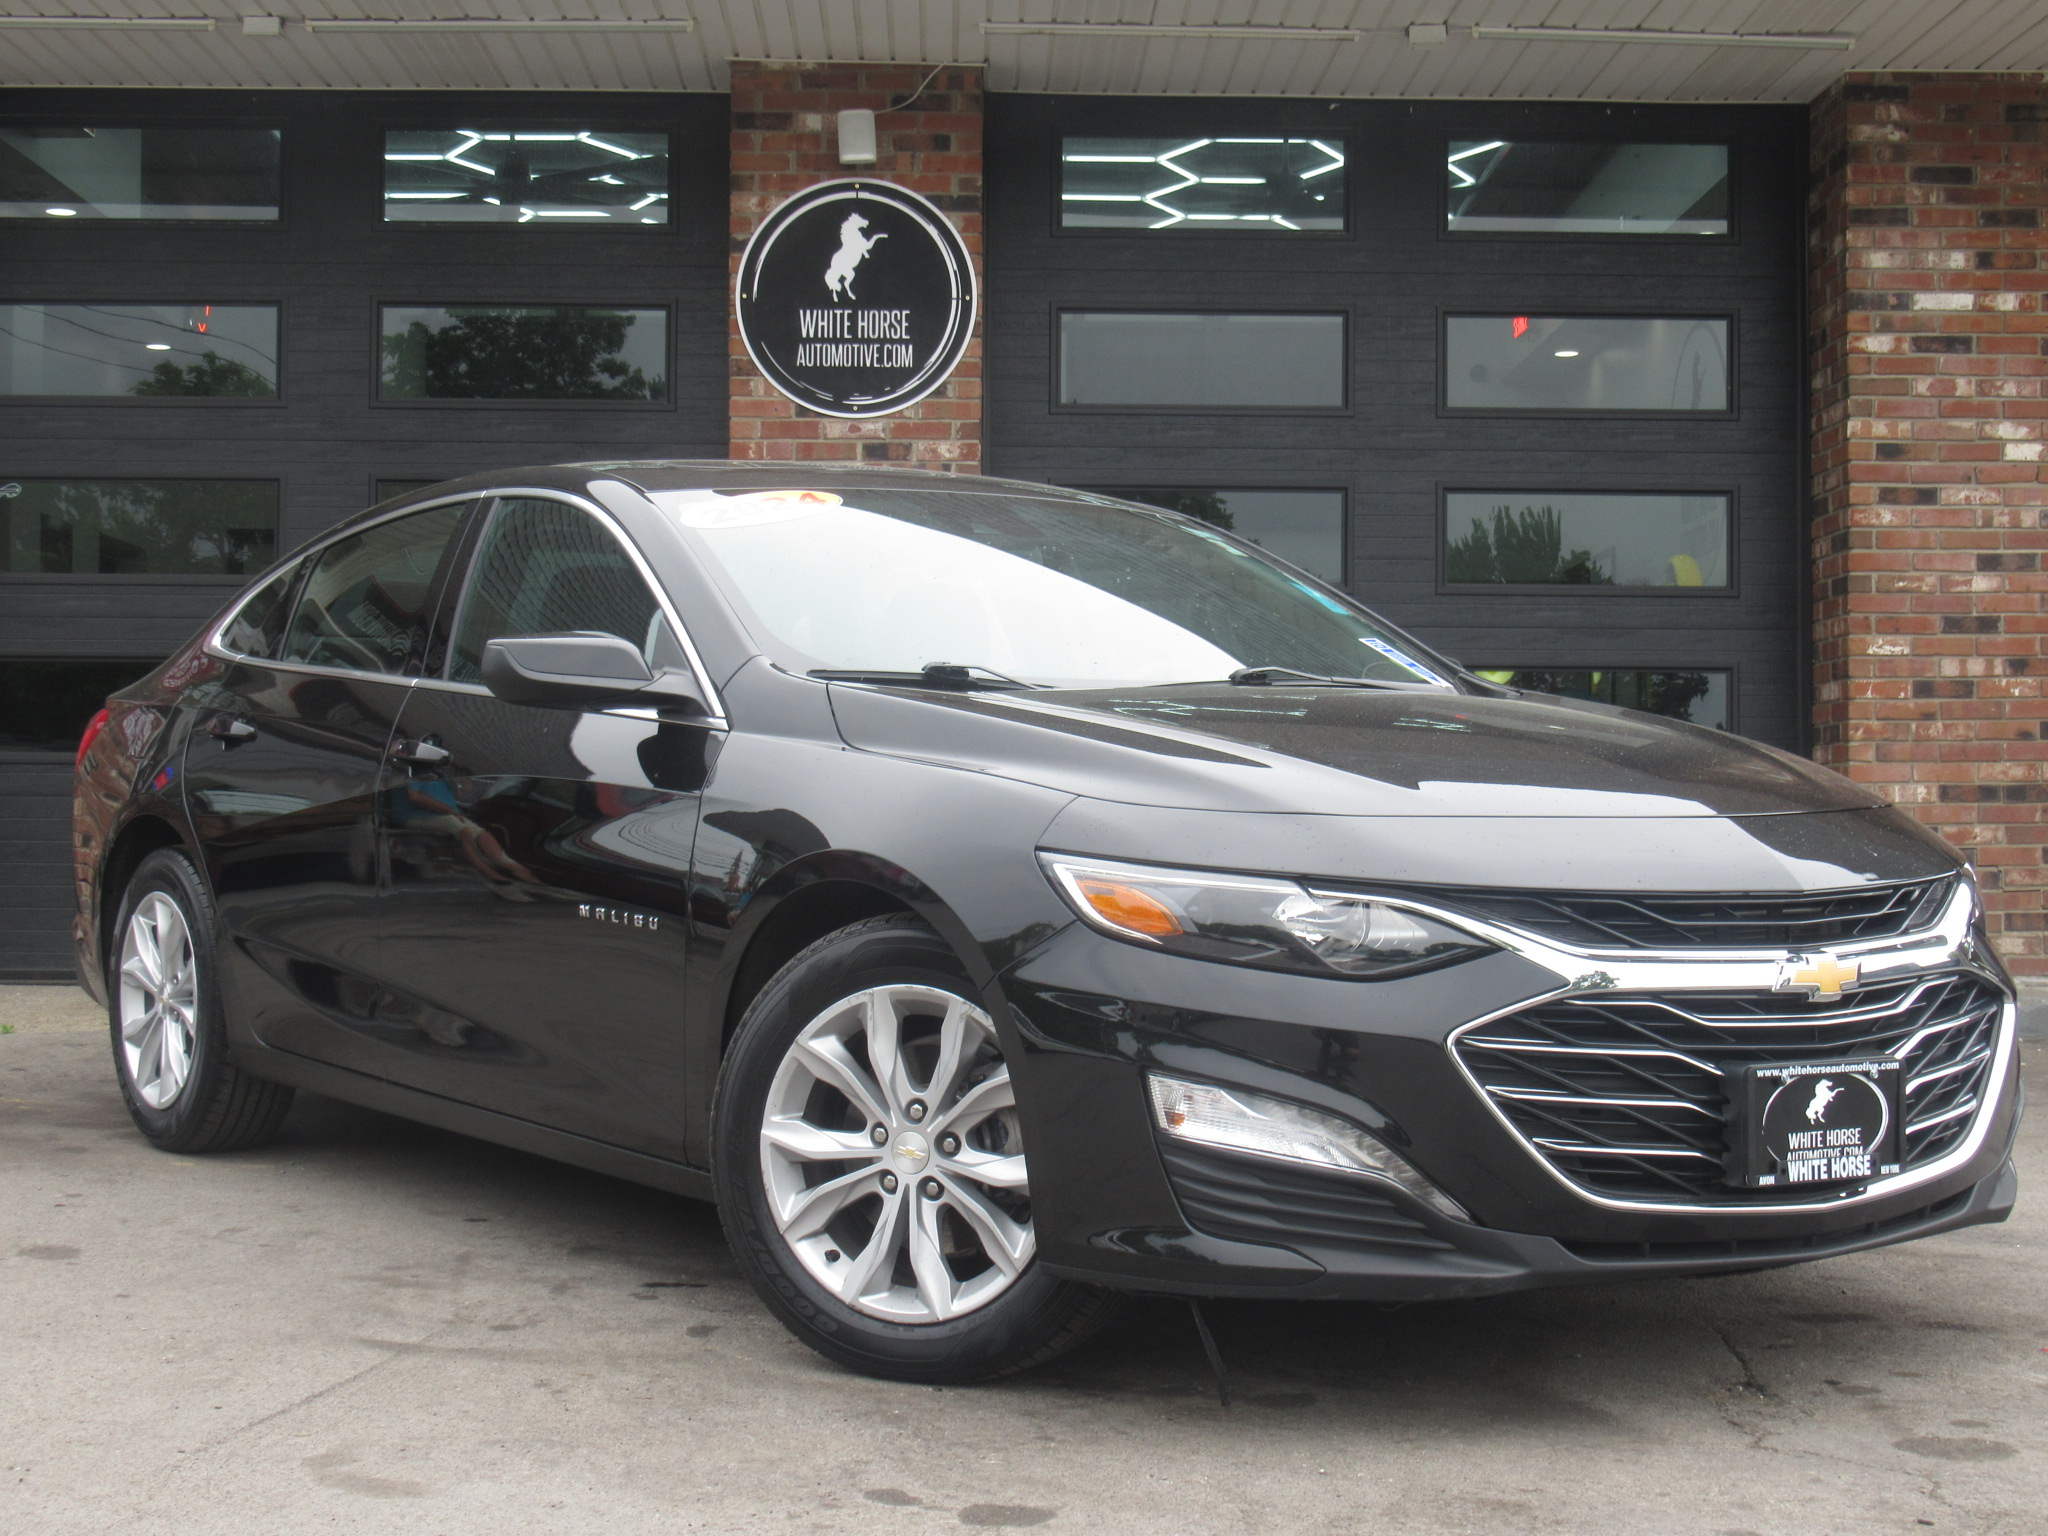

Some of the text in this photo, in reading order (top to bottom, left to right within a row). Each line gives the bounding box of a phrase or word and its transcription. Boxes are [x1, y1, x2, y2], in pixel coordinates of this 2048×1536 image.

[799, 309, 911, 340] WHITE HORSE
[796, 343, 914, 368] AUTOMOTIVE.COM
[579, 904, 659, 931] MALIBU
[1756, 1061, 1900, 1078] www.whitehorseautomotive.com
[1788, 1128, 1862, 1150] WHITE HORSE
[1786, 1146, 1864, 1161] AUTOMOTIVECOM
[1787, 1155, 1871, 1182] WHITE HORSE
[1880, 1164, 1900, 1175] NEW YORK
[1758, 1176, 1775, 1186] AVON
